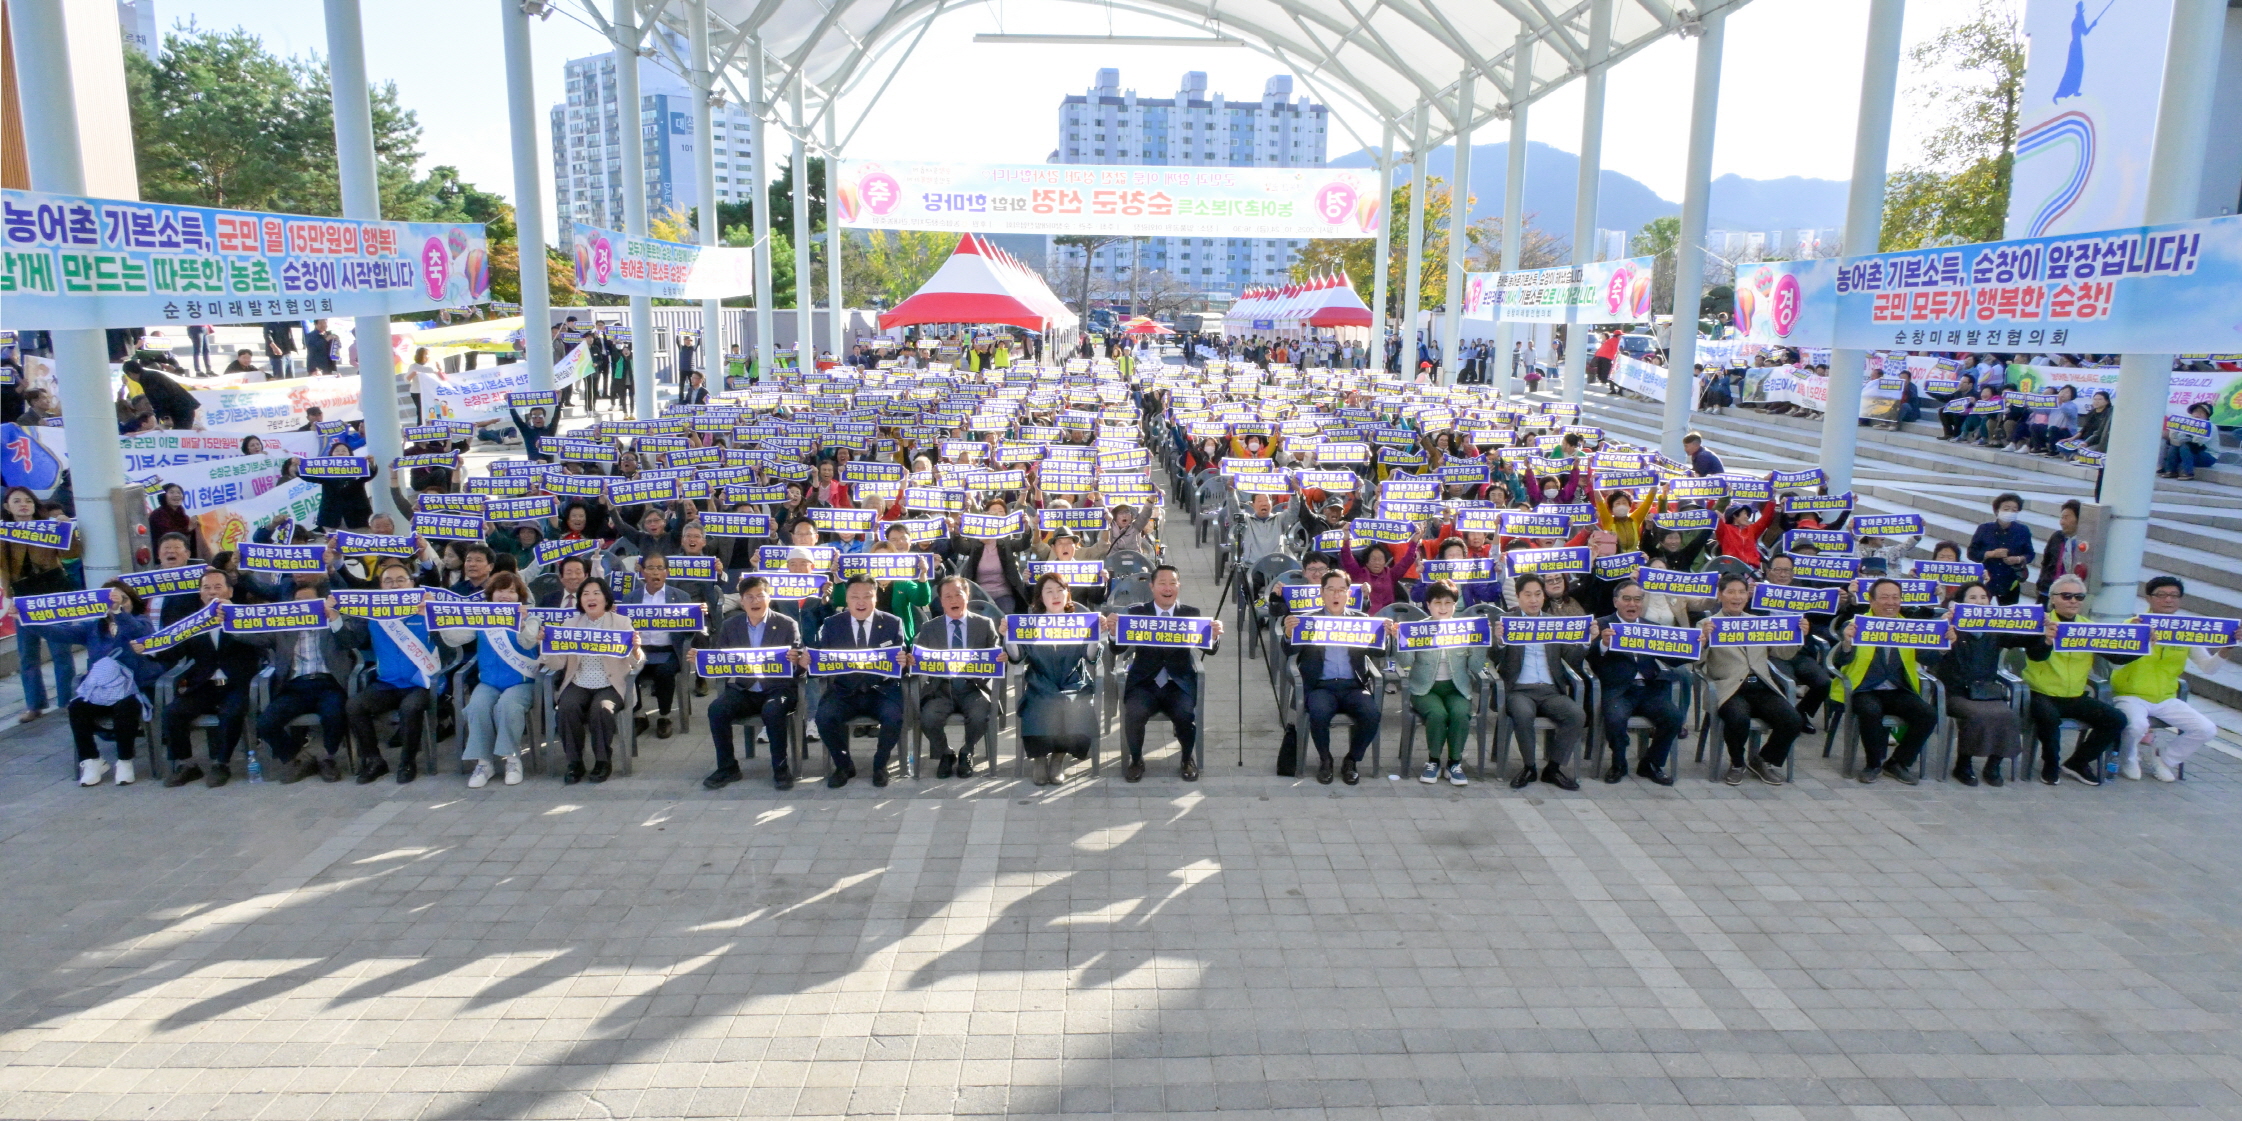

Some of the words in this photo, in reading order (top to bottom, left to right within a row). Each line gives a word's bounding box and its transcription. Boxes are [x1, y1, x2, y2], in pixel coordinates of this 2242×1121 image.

[682, 144, 693, 152] 101
[4, 202, 97, 244] 농어촌
[106, 209, 210, 253] 기본소득,
[217, 218, 259, 252] 군민
[264, 223, 284, 254] 월
[288, 224, 357, 255] 15만원의
[362, 227, 397, 257] 행복!
[628, 241, 645, 255] 모두가
[646, 243, 661, 258] 든든한
[599, 249, 608, 275] 경
[1836, 264, 1882, 294] 농어촌
[1888, 256, 1963, 290] 기본소득,
[1974, 250, 2040, 284] 순창이
[2047, 233, 2199, 279] 앞장섭니다!
[61, 254, 146, 293] 만드는
[154, 257, 223, 293] 따뜻한
[229, 260, 278, 294] 농촌,
[282, 261, 336, 292] 순창이
[341, 263, 413, 292] 시작합니다
[428, 252, 444, 286] 축
[620, 258, 644, 279] 농어촌
[646, 262, 669, 280] 기본소득
[1611, 276, 1623, 305] 축
[1780, 285, 1795, 325] 경
[1873, 292, 1908, 321] 군민
[1912, 287, 1970, 321] 모두가
[1976, 287, 2045, 318] 행복한
[2052, 283, 2113, 318] 순창!
[461, 378, 515, 394] 농촌기본소득
[1763, 378, 1797, 392] 순창군에서
[463, 395, 490, 407] 순창군
[2169, 391, 2192, 404] 최종
[206, 407, 258, 426] 농촌기본소득
[135, 438, 155, 448] 군민
[159, 437, 178, 448] 이면
[181, 438, 201, 450] 매달
[202, 438, 239, 450] 15만원씩
[263, 439, 282, 450] 지급!
[209, 468, 231, 480] 순창군
[232, 458, 272, 475] 농촌기본소득
[199, 482, 244, 508] 현실로!
[704, 515, 724, 524] 모두가
[726, 516, 746, 524] 든든한
[748, 517, 765, 525] 순창!
[1509, 515, 1560, 526] 농어촌기본소득
[704, 524, 725, 533] 성과를
[727, 525, 740, 533] 넘어
[743, 526, 764, 534] 미래로!
[1505, 524, 1526, 534] 열심히
[1528, 525, 1564, 535] 하겠습니다!
[1647, 572, 1707, 583] 농어촌기본소득
[1643, 580, 1667, 590] 열심히
[1669, 582, 1711, 594] 하겠습니다!
[433, 606, 460, 615] 모두가
[463, 607, 490, 615] 든든한
[494, 606, 515, 615] 순창!
[627, 608, 689, 617] 농어촌기본소득
[435, 616, 464, 626] 성과를
[467, 616, 484, 625] 넘어
[488, 616, 515, 626] 미래로!
[633, 619, 648, 628] 심히
[652, 618, 695, 628] 하겠습니다!
[1019, 616, 1085, 627] 농어촌기본소득
[1129, 619, 1197, 631] 농어촌기본소득
[1508, 621, 1535, 631] 모두가
[1537, 622, 1564, 631] 든든한
[1567, 620, 1586, 630] 순창!
[1721, 619, 1788, 631] 농어촌기본소득
[1865, 620, 1936, 632] 농어촌기본소득
[2150, 618, 2223, 632] 농어촌기본소득
[554, 630, 622, 643] 농어촌기본소득
[1015, 628, 1042, 639] 열심히
[1044, 628, 1091, 638] 하겠습니다!
[1126, 630, 1152, 641] 열심히
[1155, 632, 1202, 644] 하겠습니다!
[1507, 631, 1533, 641] 성과를
[1536, 631, 1553, 640] 넘어
[1556, 630, 1584, 640] 미래로!
[1623, 625, 1688, 641] 농어촌기본소득
[1718, 632, 1744, 643] 열심히
[1747, 631, 1794, 642] 하겠습니다!
[1860, 631, 1888, 643] 열심히
[1891, 633, 1940, 645] 하겠습니다!
[2067, 626, 2136, 639] 농어촌기본소득
[551, 641, 578, 650] 열심히
[581, 642, 627, 653] 하겠습니다!
[1619, 636, 1645, 649] 열심히
[1648, 641, 1692, 654] 하겠습니다!
[2061, 637, 2087, 648] 열심히
[2090, 638, 2140, 651] 하겠습니다!
[707, 652, 775, 663] 농어촌기본소득
[705, 664, 732, 674] 열심히
[735, 663, 783, 674] 하겠습니다!
